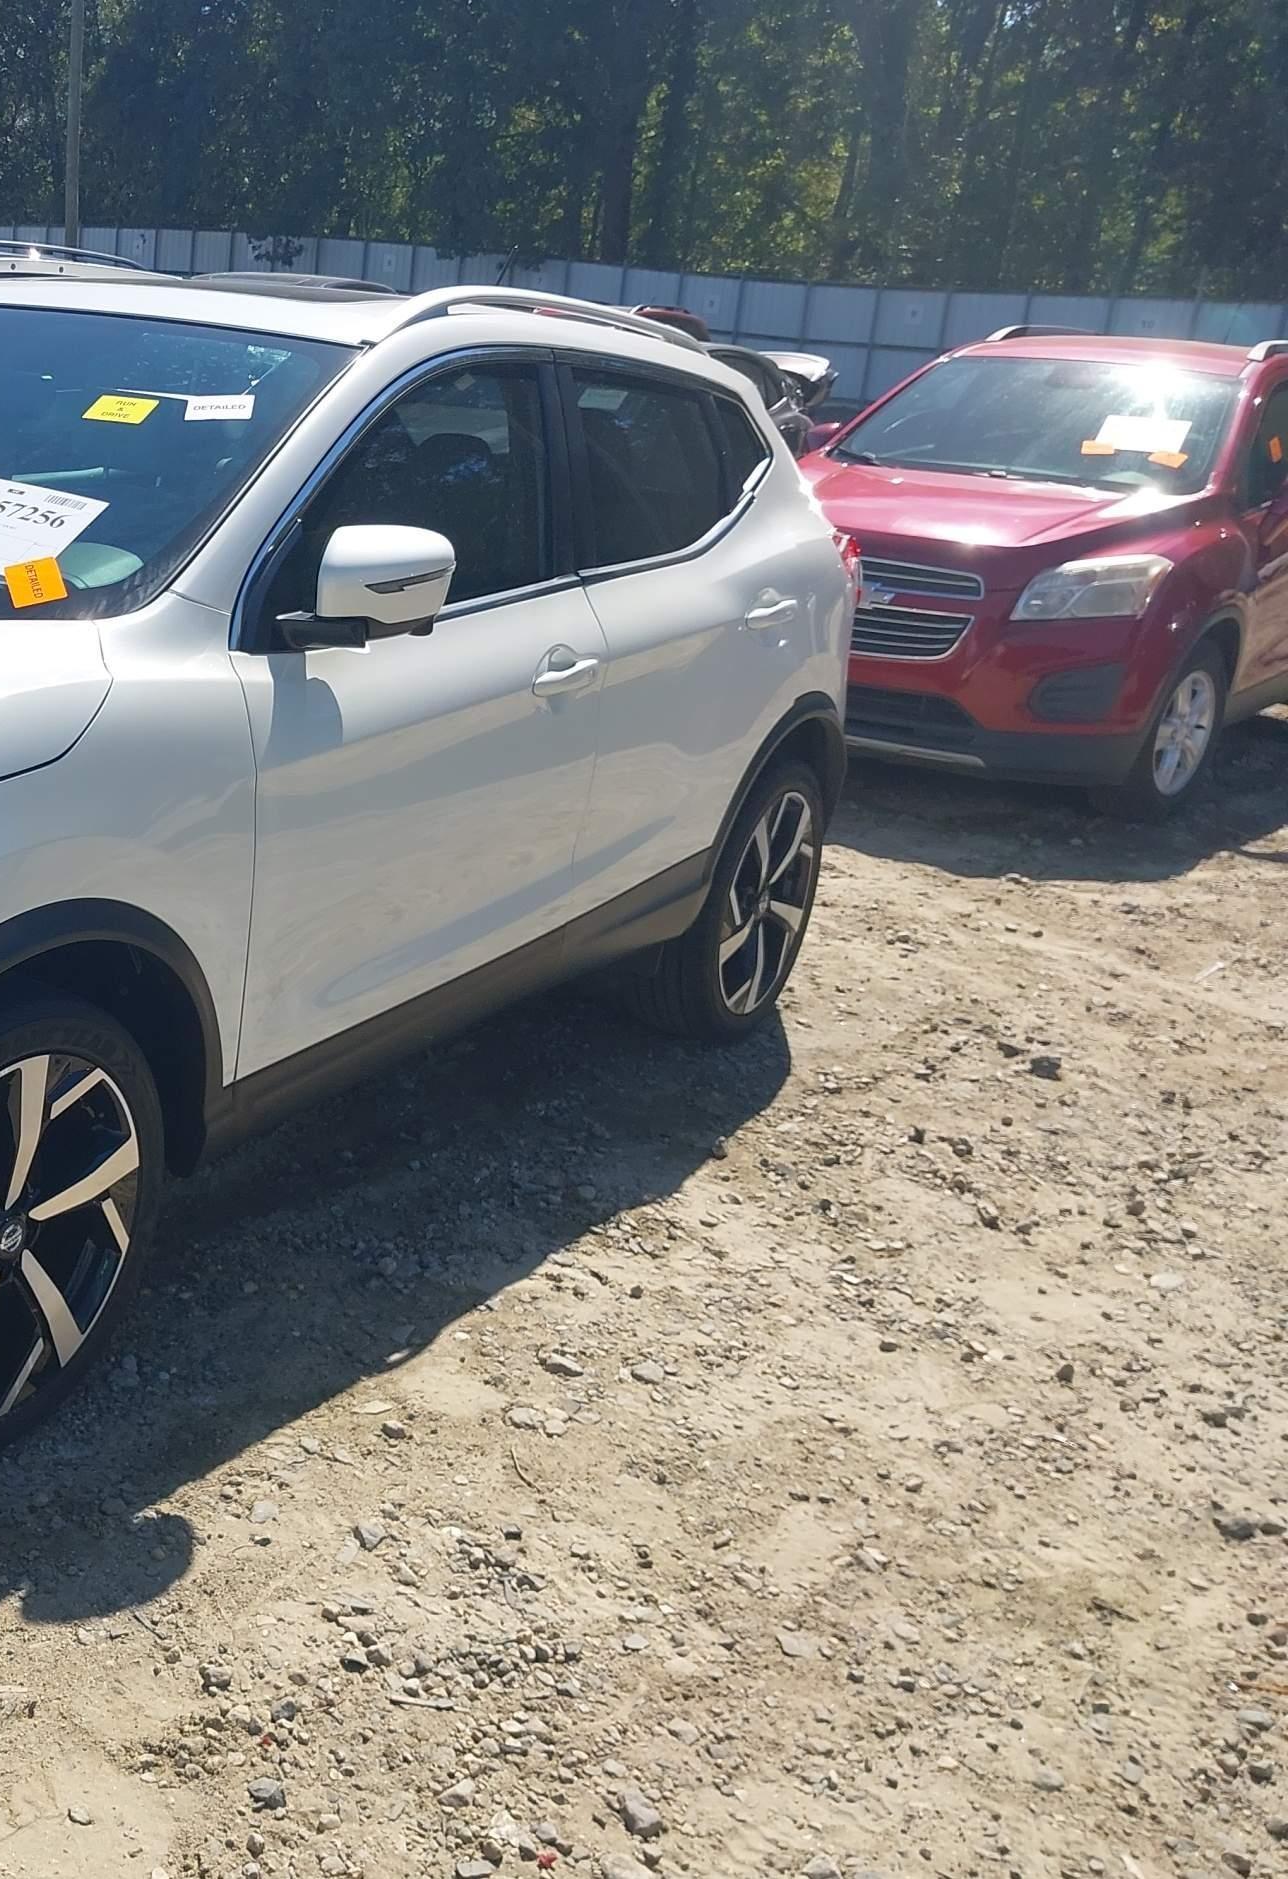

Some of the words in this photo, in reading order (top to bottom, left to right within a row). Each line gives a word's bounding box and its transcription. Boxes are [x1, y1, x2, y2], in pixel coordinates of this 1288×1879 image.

[192, 403, 247, 411] DETAILED
[100, 411, 131, 419] DRIVE
[24, 563, 45, 599] DETAILED
